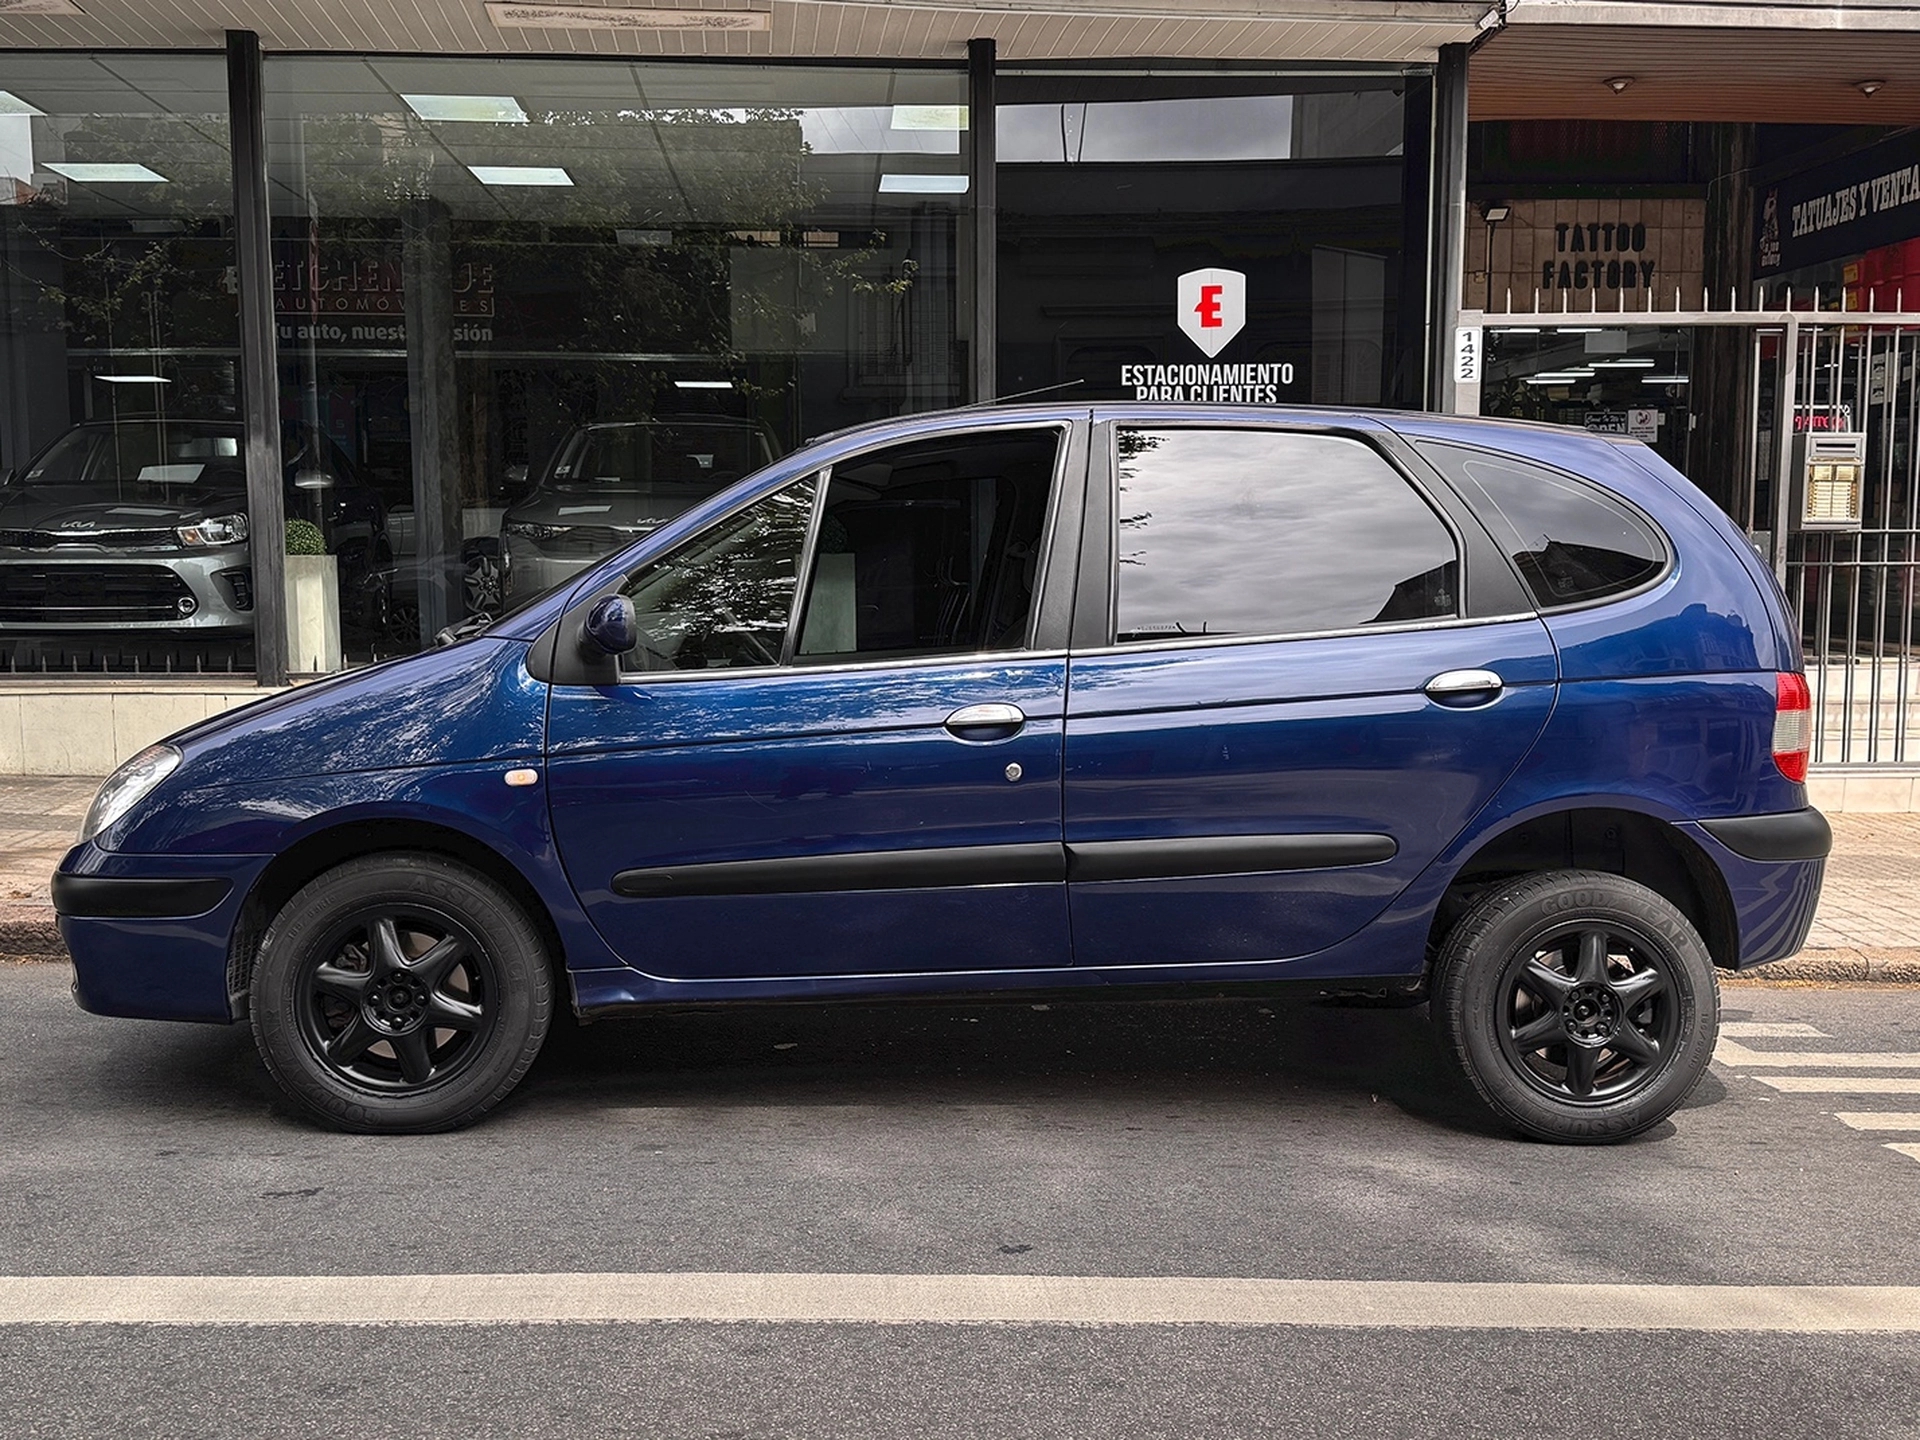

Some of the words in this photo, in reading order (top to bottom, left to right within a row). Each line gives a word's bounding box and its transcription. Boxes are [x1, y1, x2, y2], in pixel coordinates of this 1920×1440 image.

[1791, 185, 1857, 238] TATUAJES
[1859, 181, 1870, 217] Y
[1555, 223, 1646, 252] TATTOO
[1542, 260, 1655, 289] FACTORY
[1461, 331, 1474, 379] 1422
[1121, 364, 1294, 386] ESTACIONAMIENTO
[1136, 386, 1184, 401] PARA
[1190, 385, 1278, 403] CLIENTES
